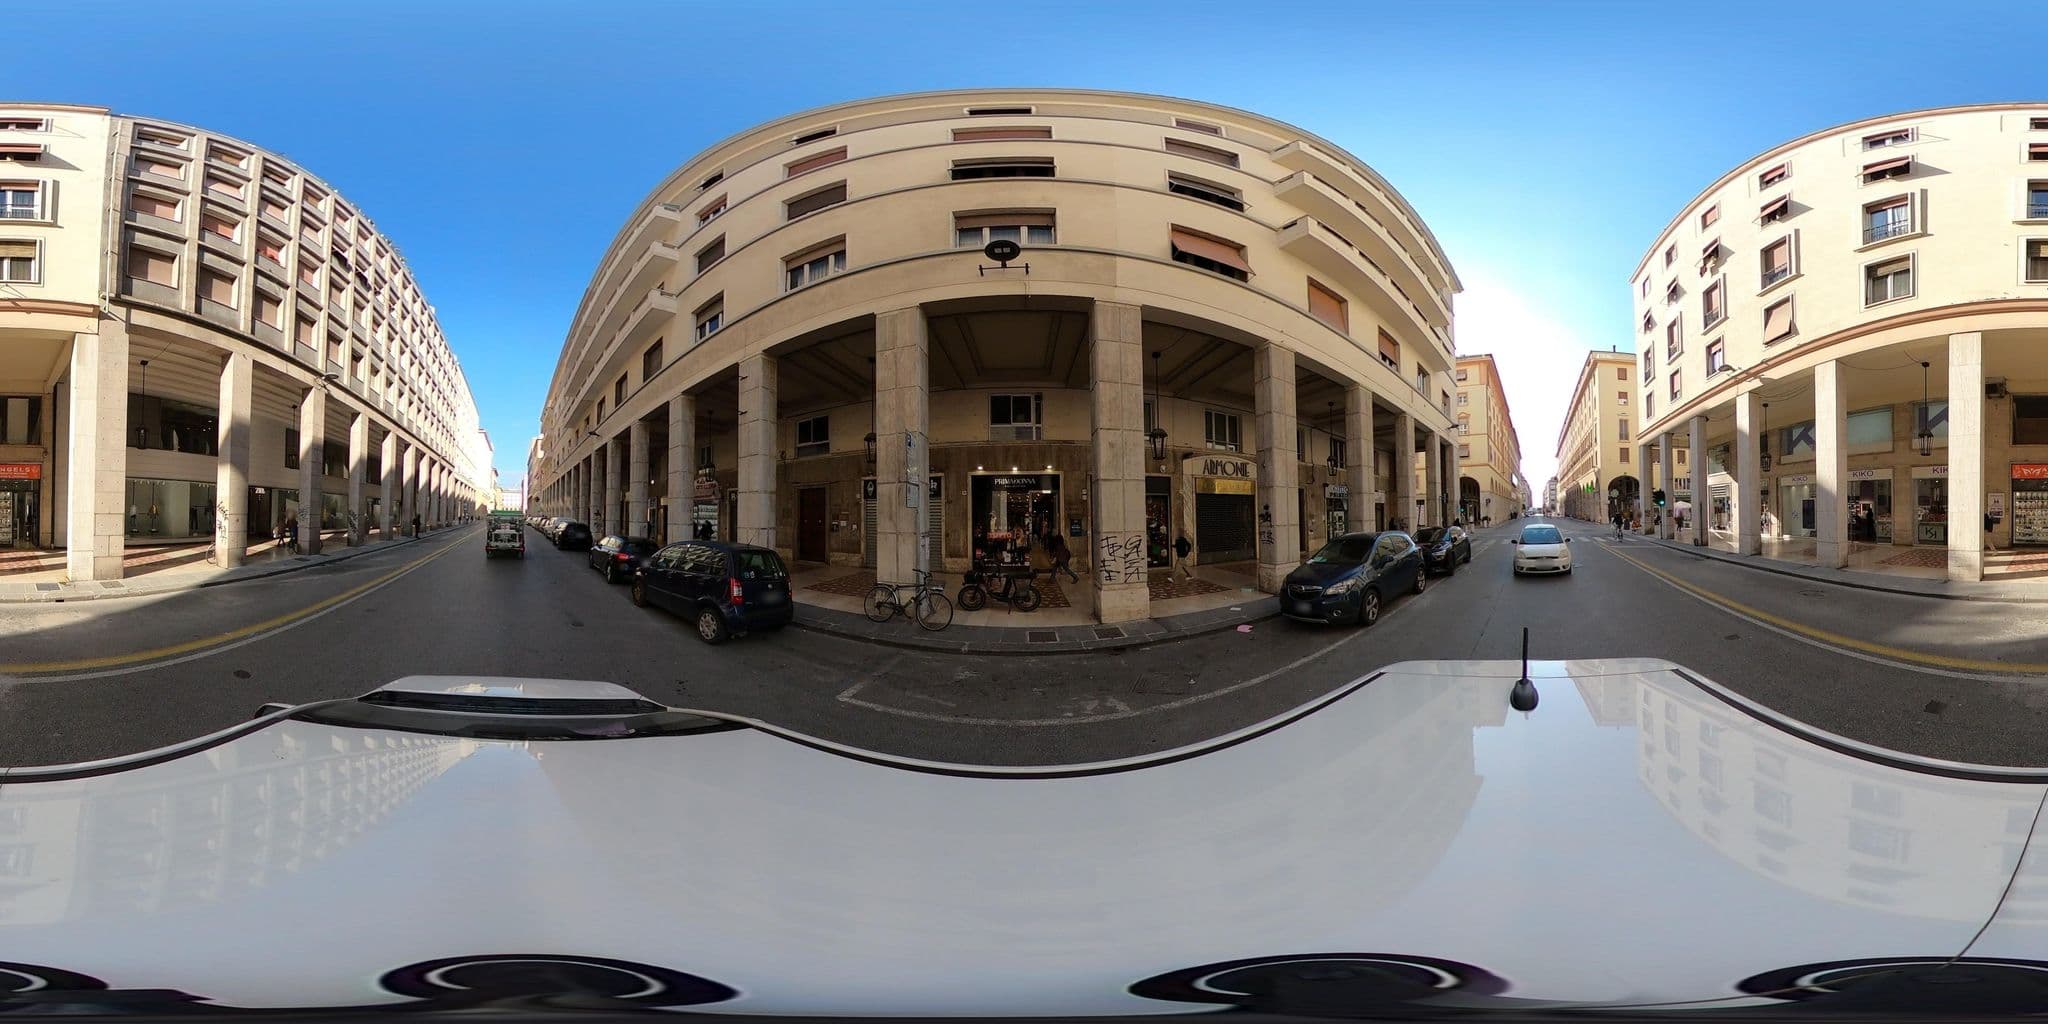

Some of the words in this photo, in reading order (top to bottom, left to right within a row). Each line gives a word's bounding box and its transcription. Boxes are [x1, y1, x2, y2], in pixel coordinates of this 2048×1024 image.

[1203, 459, 1250, 478] ARMONIE
[1932, 466, 1949, 474] KIK
[1792, 474, 1808, 482] KIKO
[1852, 470, 1874, 478] KIKO
